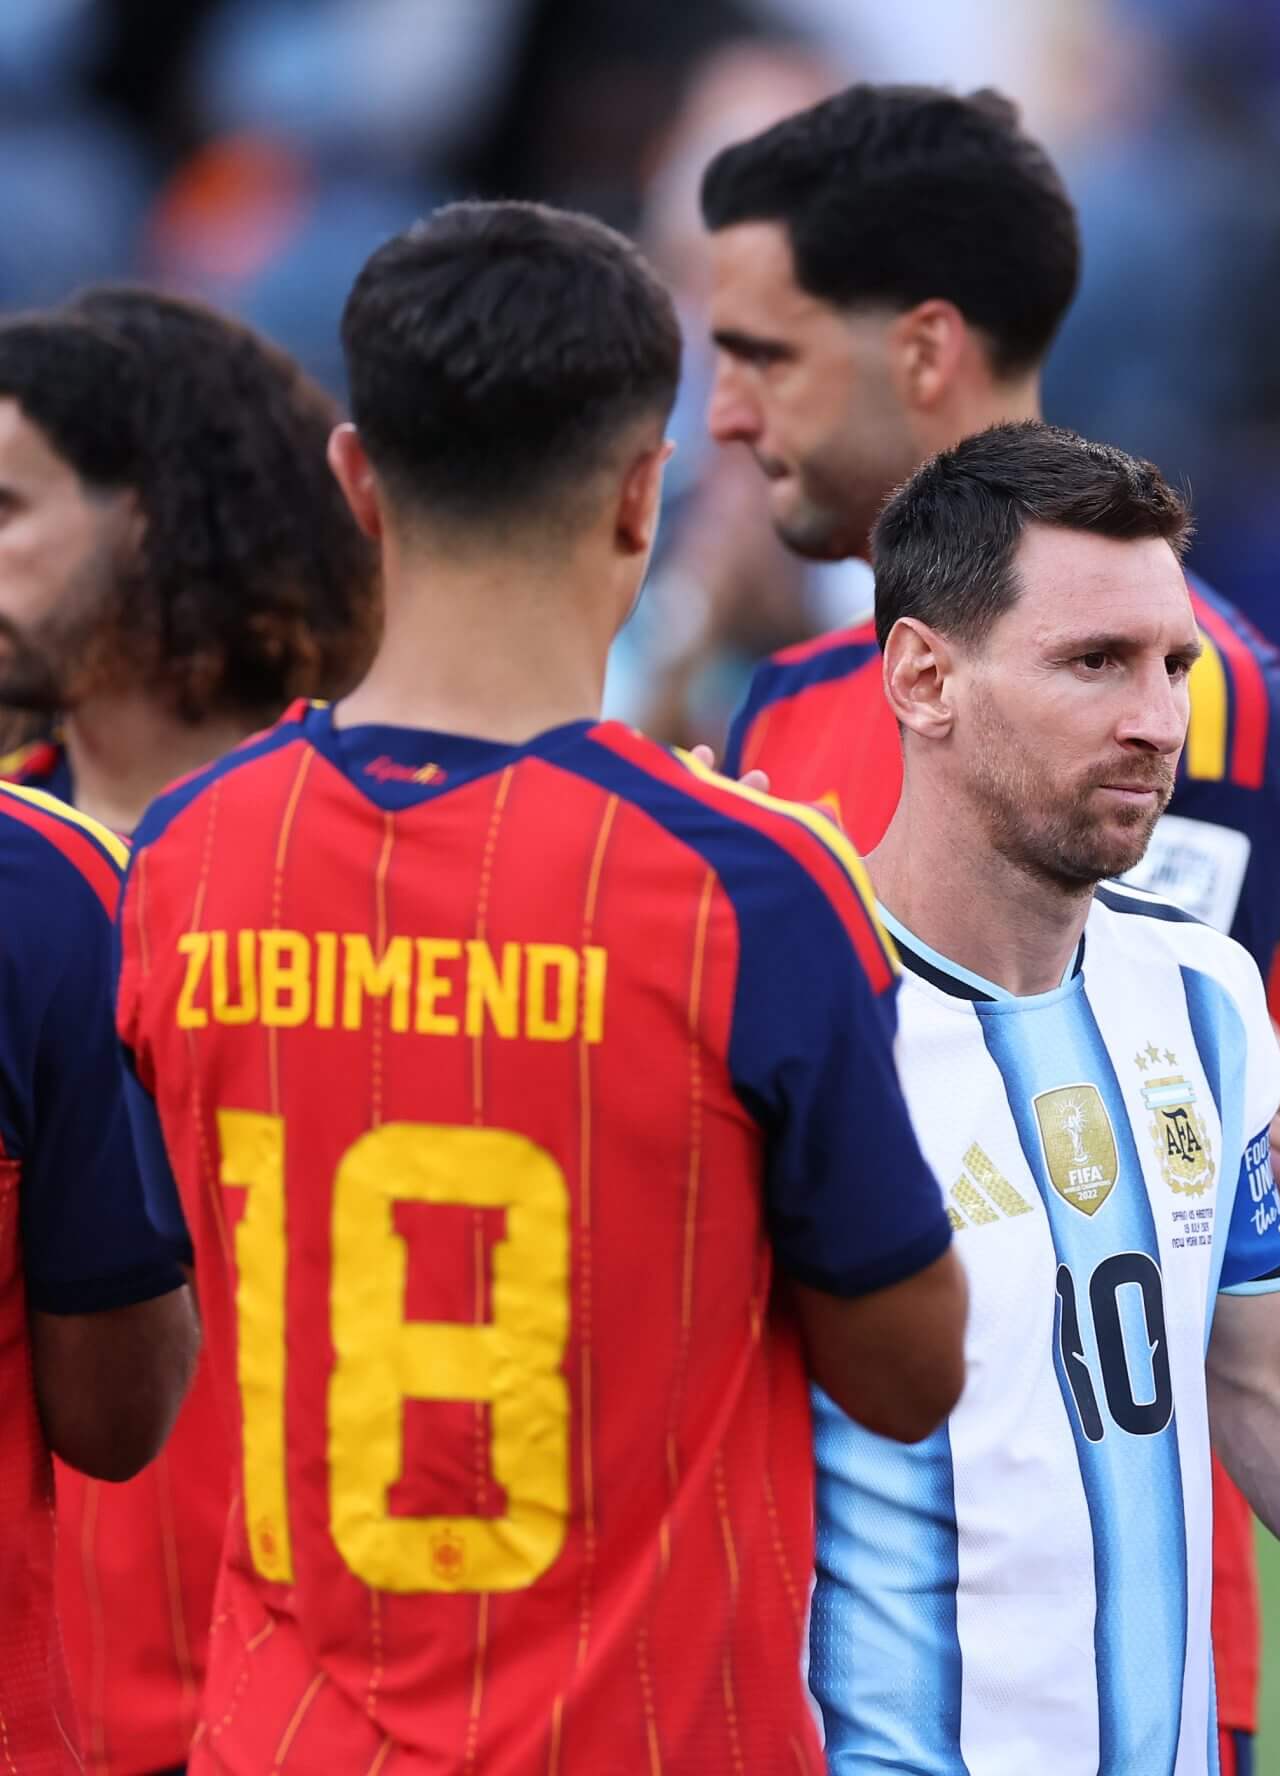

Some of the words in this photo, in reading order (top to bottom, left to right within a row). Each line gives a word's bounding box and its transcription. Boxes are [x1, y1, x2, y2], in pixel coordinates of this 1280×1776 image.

[176, 930, 606, 1043] ZUBIMENDI
[1068, 1165, 1103, 1186] FIFA
[1162, 1108, 1202, 1162] AFA
[217, 1107, 570, 1593] 18
[1056, 1252, 1175, 1442] 10
